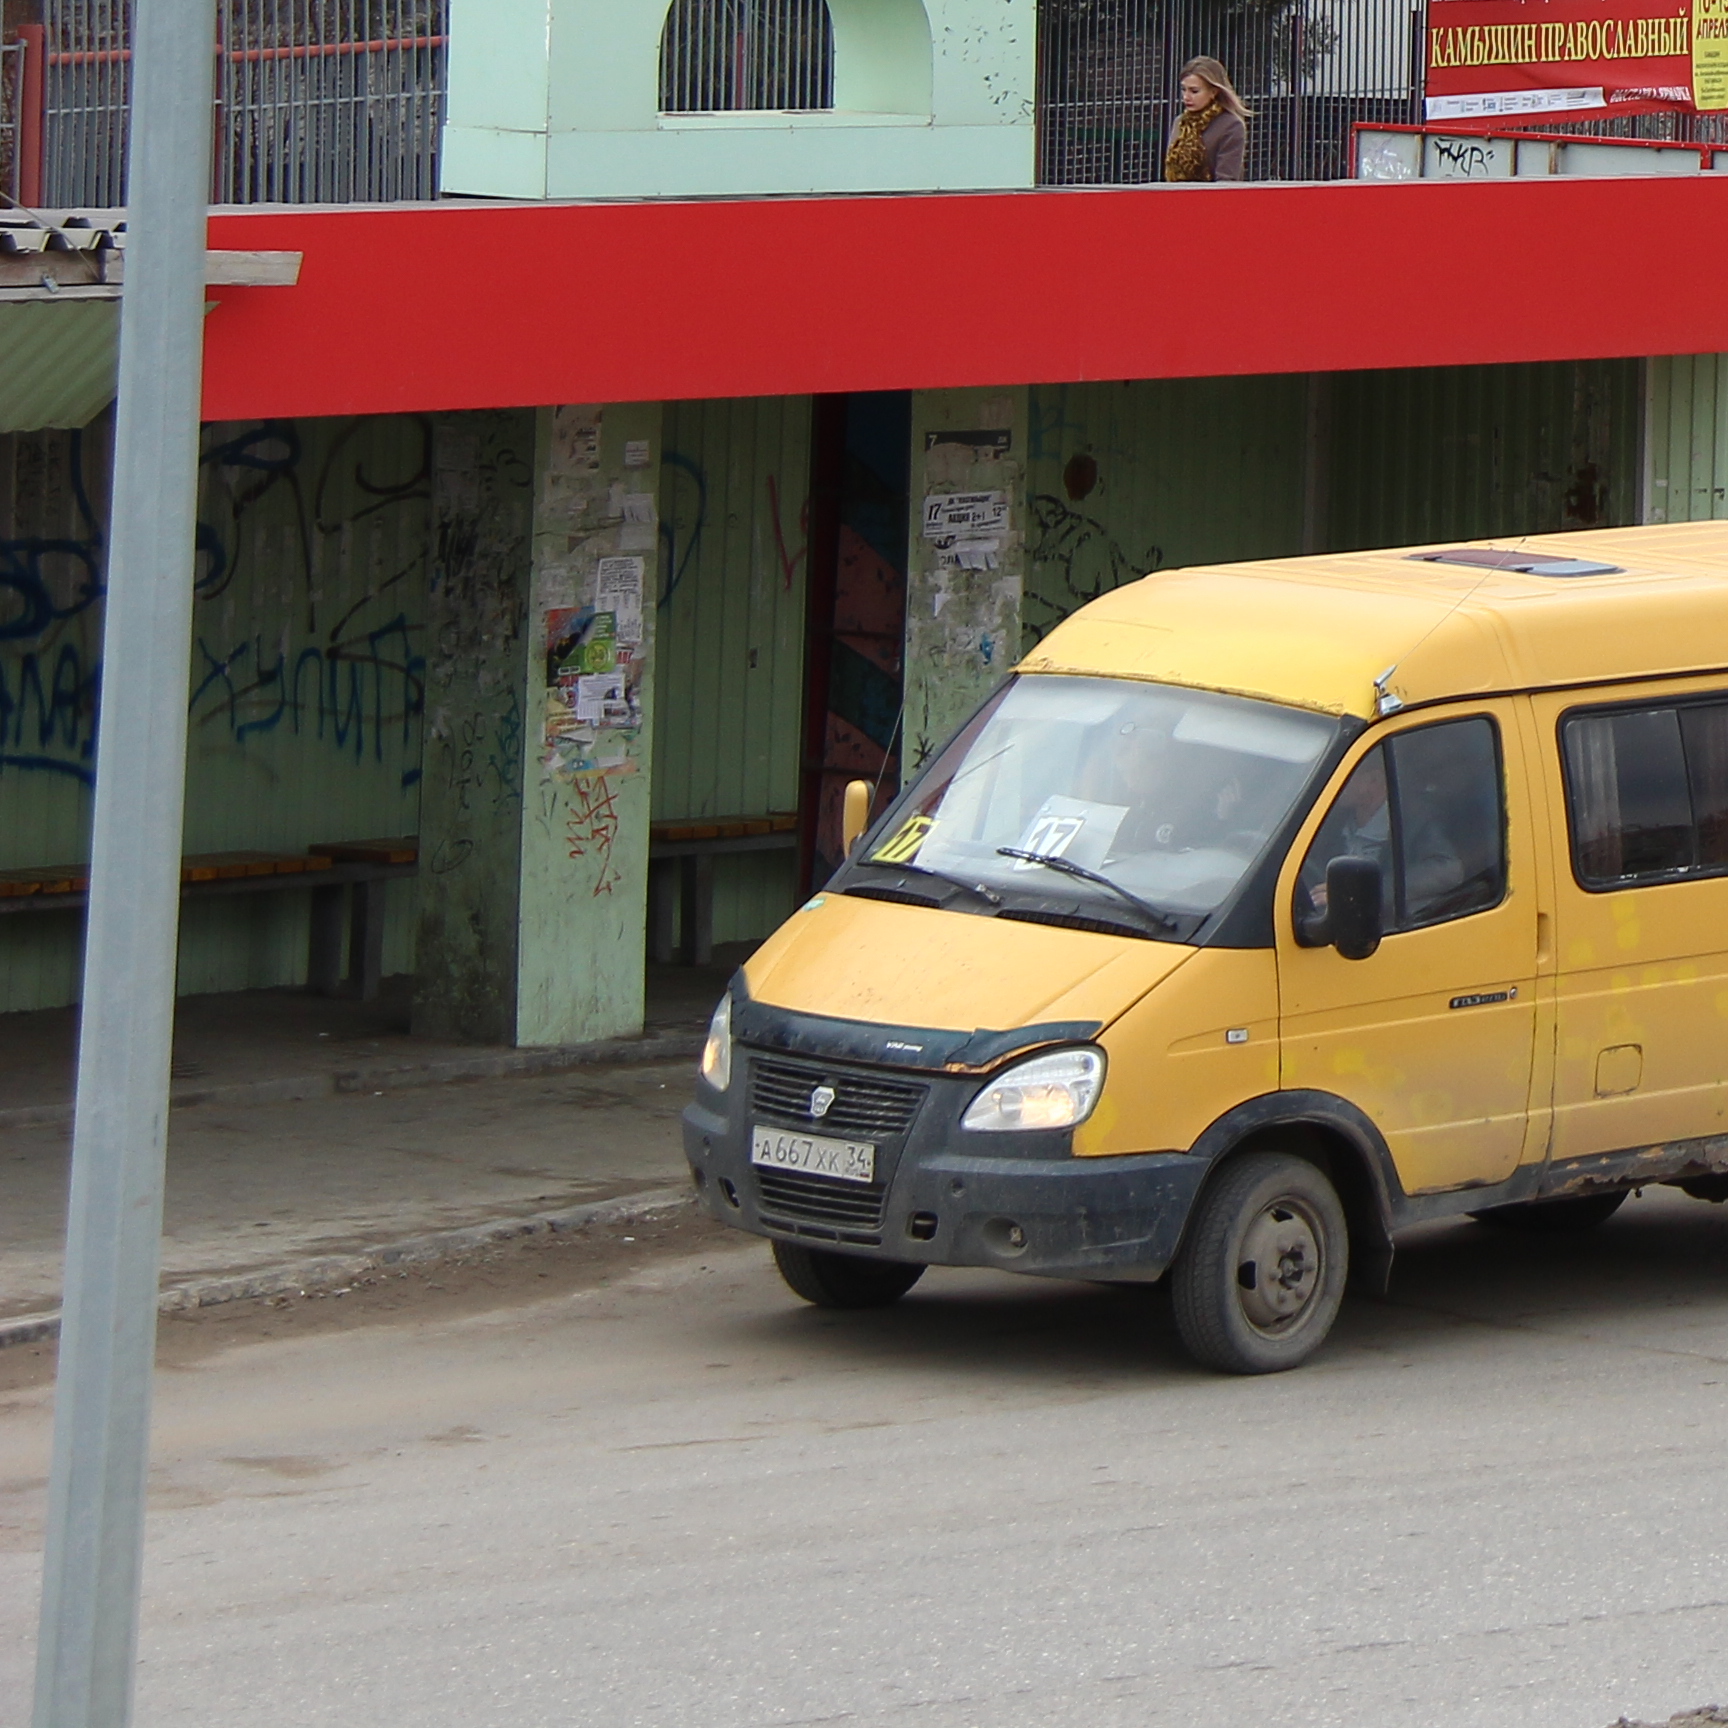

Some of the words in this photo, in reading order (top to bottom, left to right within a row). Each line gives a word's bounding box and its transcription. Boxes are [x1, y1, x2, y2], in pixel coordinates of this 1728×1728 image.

[1430, 23, 1538, 68] КАМЫШИН
[1540, 7, 1689, 62] ПРАВОСЛАВНЫЙ
[928, 503, 942, 521] 17
[881, 821, 930, 859] 17
[1030, 820, 1078, 859] 17
[847, 1145, 867, 1170] 34
